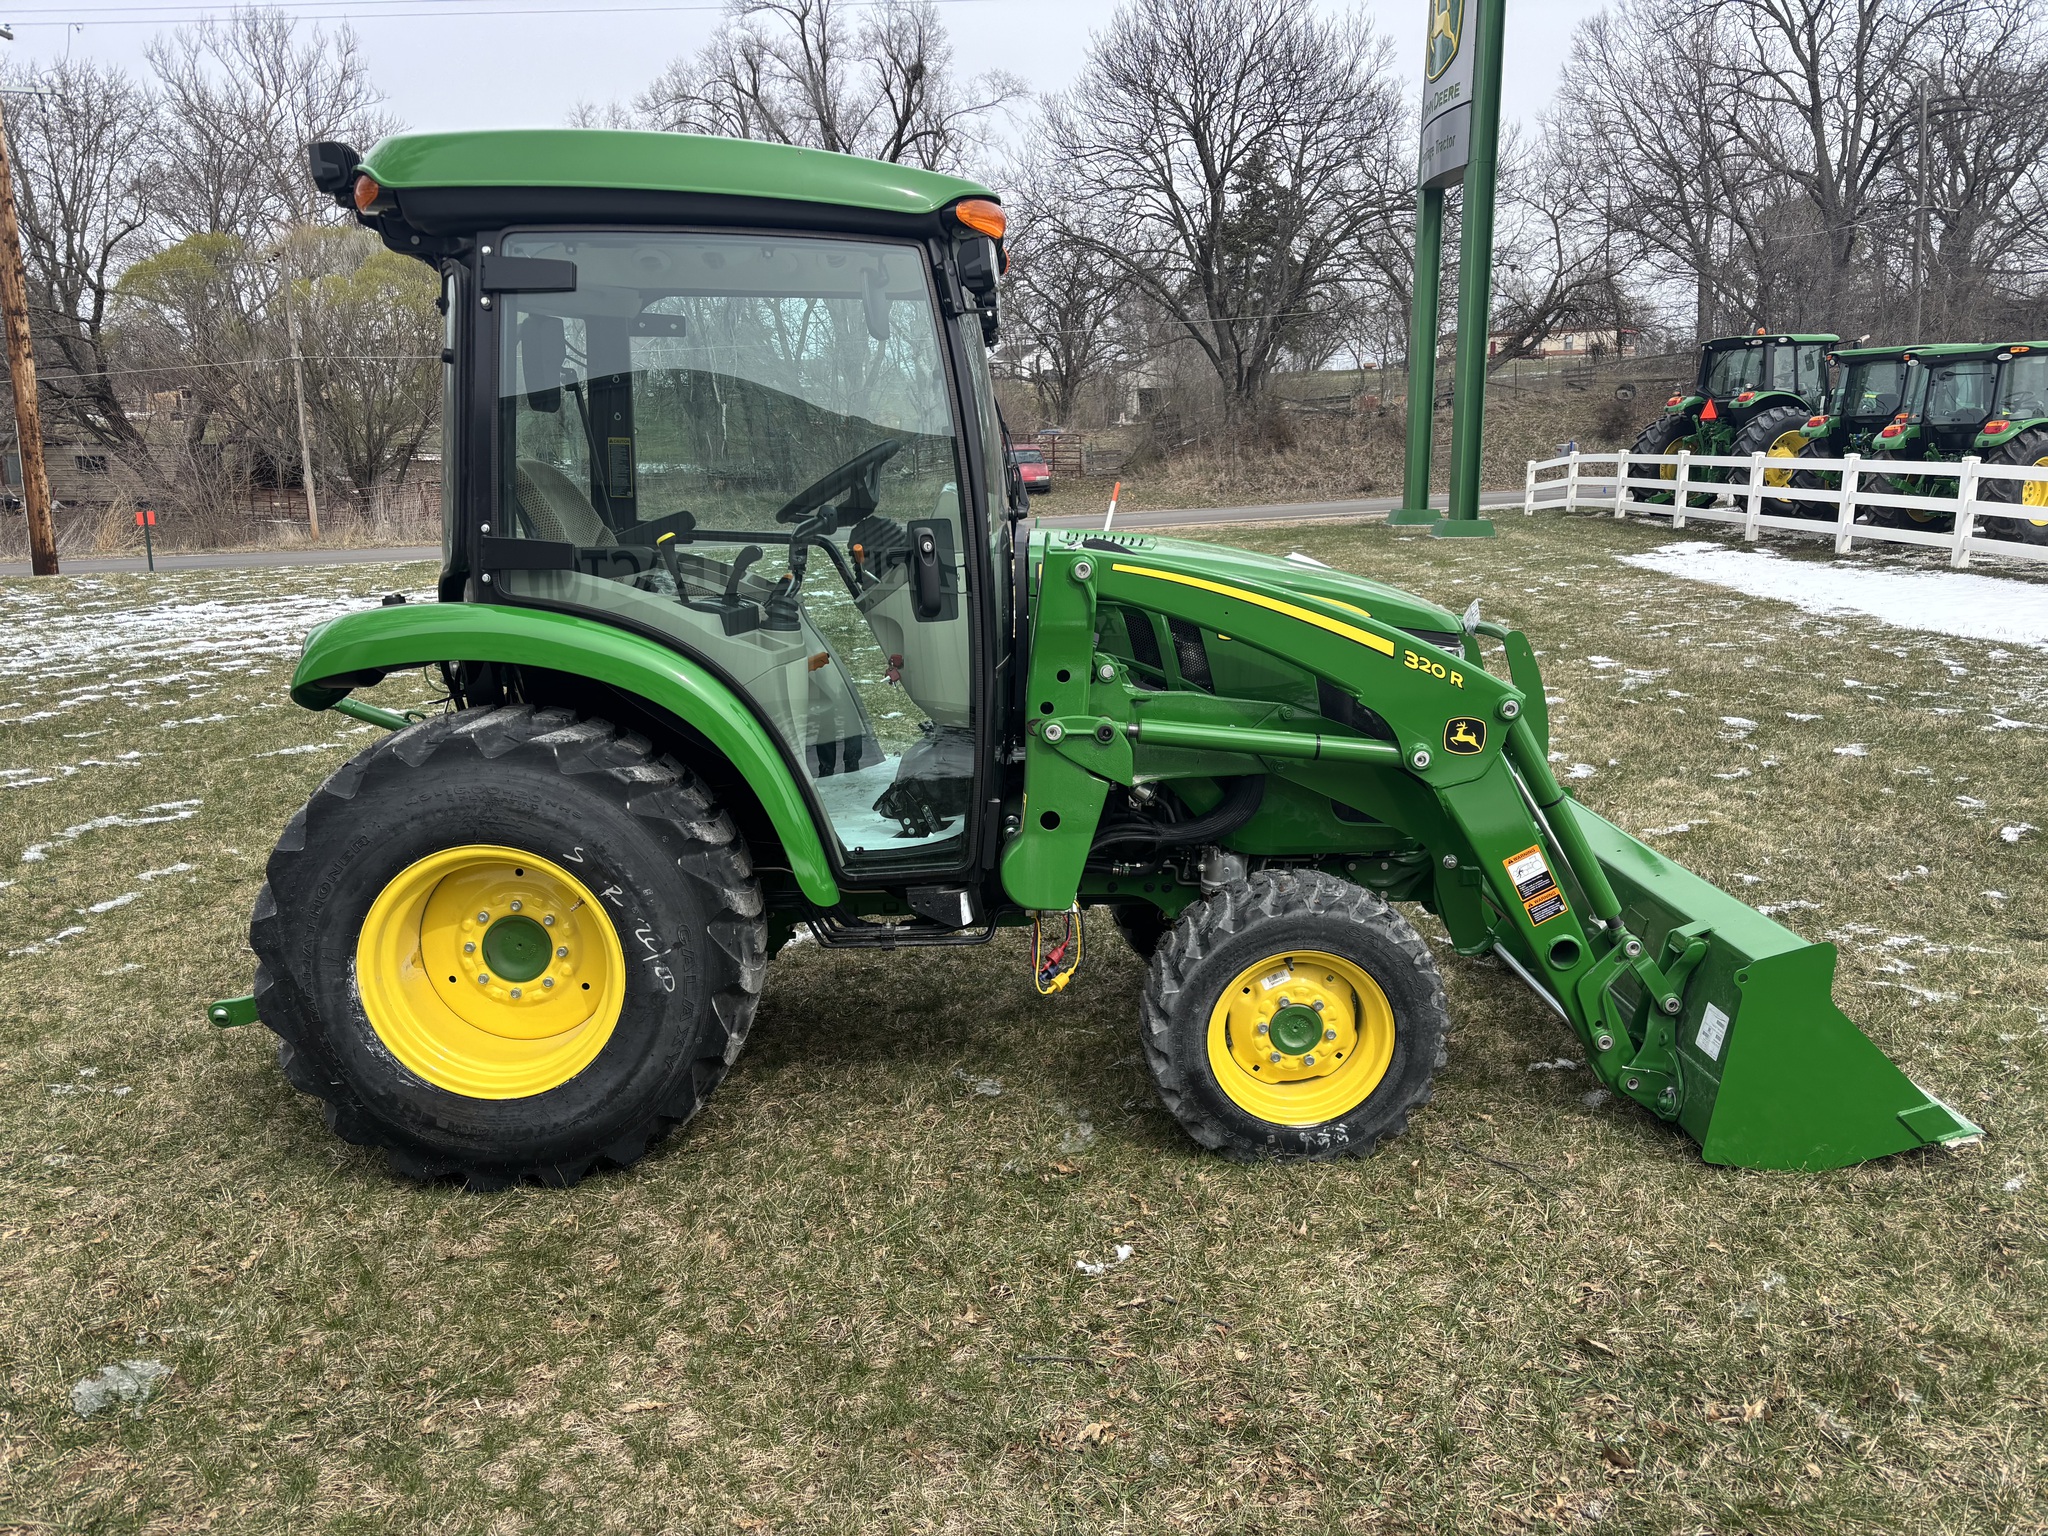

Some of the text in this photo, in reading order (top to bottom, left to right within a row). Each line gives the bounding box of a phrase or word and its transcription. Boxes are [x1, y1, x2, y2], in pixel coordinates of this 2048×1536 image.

[1434, 82, 1460, 108] DEERE
[1435, 134, 1456, 154] Tractor
[1403, 649, 1464, 689] 320 R
[1513, 848, 1536, 862] WARNING
[1533, 890, 1557, 904] WARNING
[664, 924, 697, 1071] GALAXY
